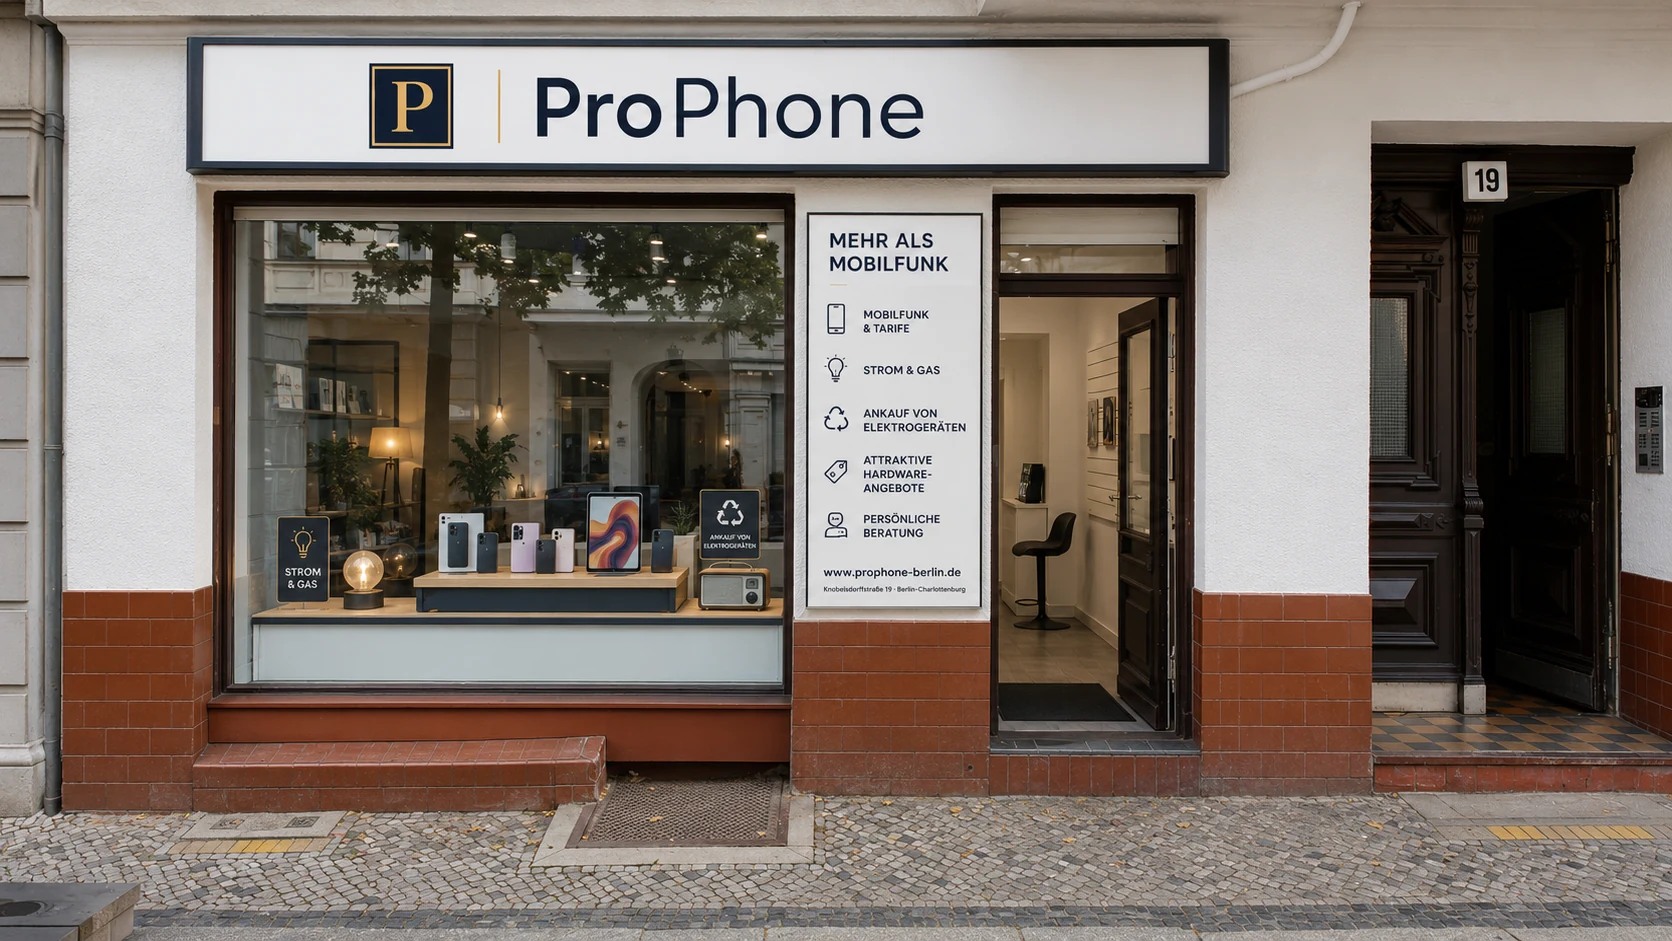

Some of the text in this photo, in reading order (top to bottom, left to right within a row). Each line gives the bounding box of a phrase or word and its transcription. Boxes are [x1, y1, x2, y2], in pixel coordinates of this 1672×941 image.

[391, 76, 923, 139] P ProPhone
[1475, 168, 1499, 192] 19
[830, 232, 934, 248] MEHR ALS
[830, 256, 948, 272] MOBILFUNK
[864, 310, 928, 320] MOBILFUNK
[864, 324, 910, 334] & TARIFE
[864, 366, 940, 374] STROM & GAS
[864, 408, 938, 418] ANKAUF VON
[864, 420, 966, 432] ELEKTROGERÄTEN
[864, 456, 932, 464] ATTRAKTIVE
[864, 470, 932, 478] HARDWARE-
[864, 484, 924, 492] ANGEBOTE
[864, 512, 940, 524] PERSÖNLICHE
[864, 528, 924, 538] BERATUNG
[284, 568, 322, 576] STROM
[824, 568, 962, 580] www.prophone-berlin.de
[288, 580, 318, 588] & GAS
[884, 586, 892, 594] 19
[896, 586, 966, 594] Berlin-Charlottenburg
